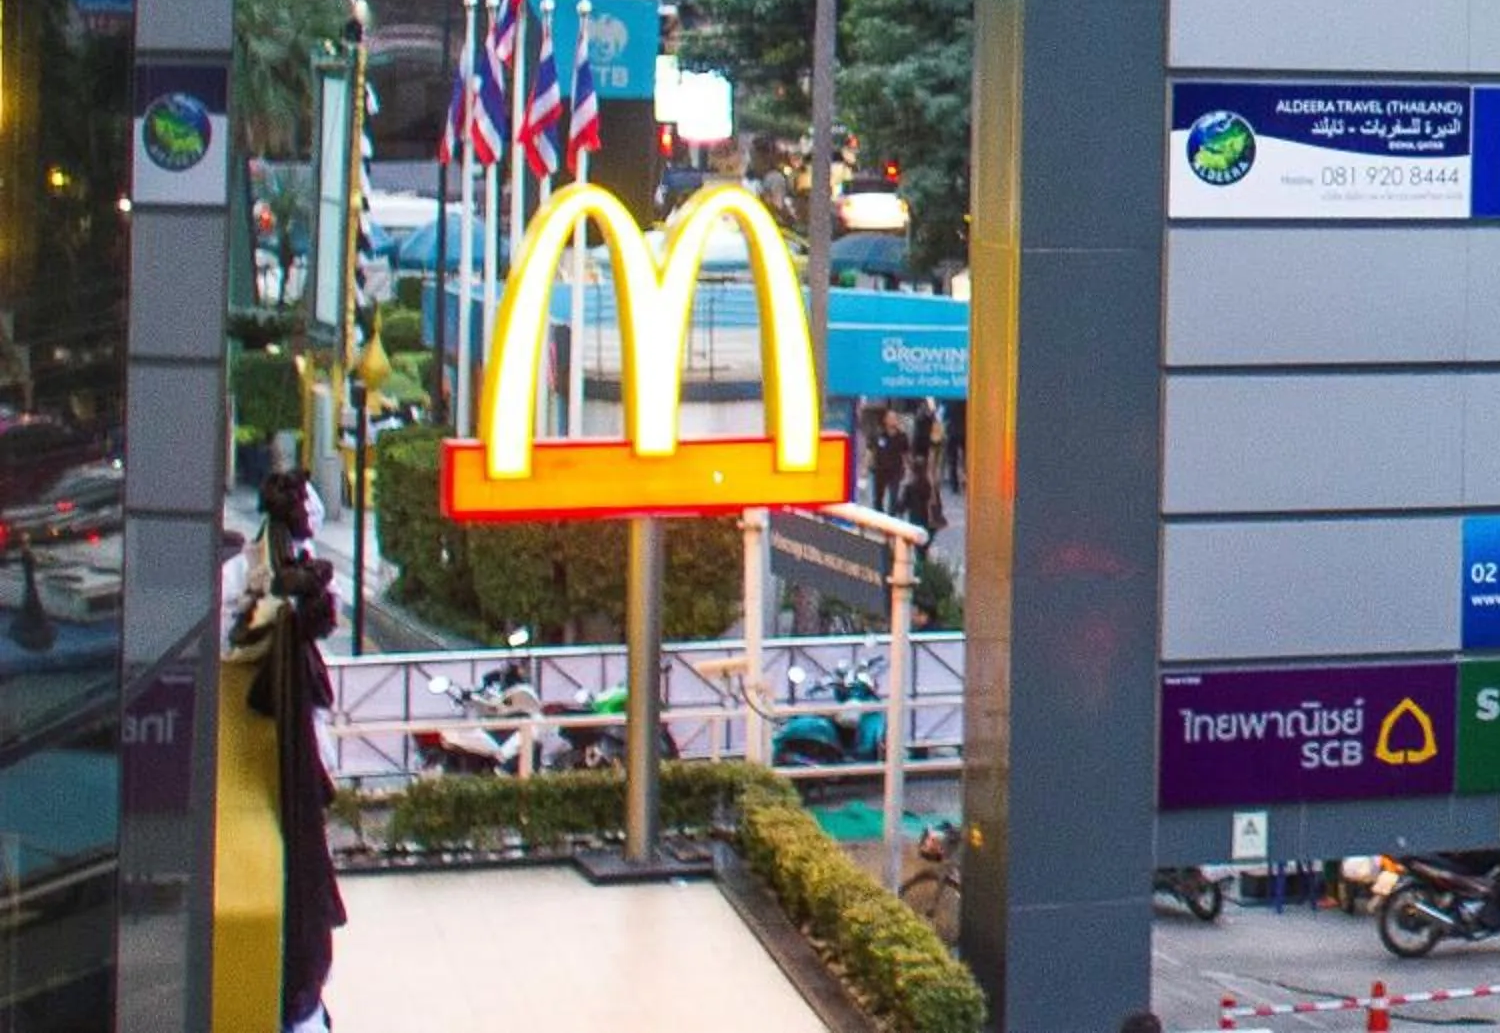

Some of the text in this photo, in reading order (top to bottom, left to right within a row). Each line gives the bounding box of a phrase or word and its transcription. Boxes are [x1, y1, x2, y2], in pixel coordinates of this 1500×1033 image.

[1275, 99, 1463, 116] ALDEERA TRAVEL (THAILAND)
[1321, 166, 1356, 186] 081
[1366, 166, 1404, 186] 920
[1410, 166, 1460, 186] 8444
[1471, 562, 1497, 583] 02
[1179, 697, 1365, 743] ไทยพาณิชย์
[1301, 740, 1364, 769] SCB
